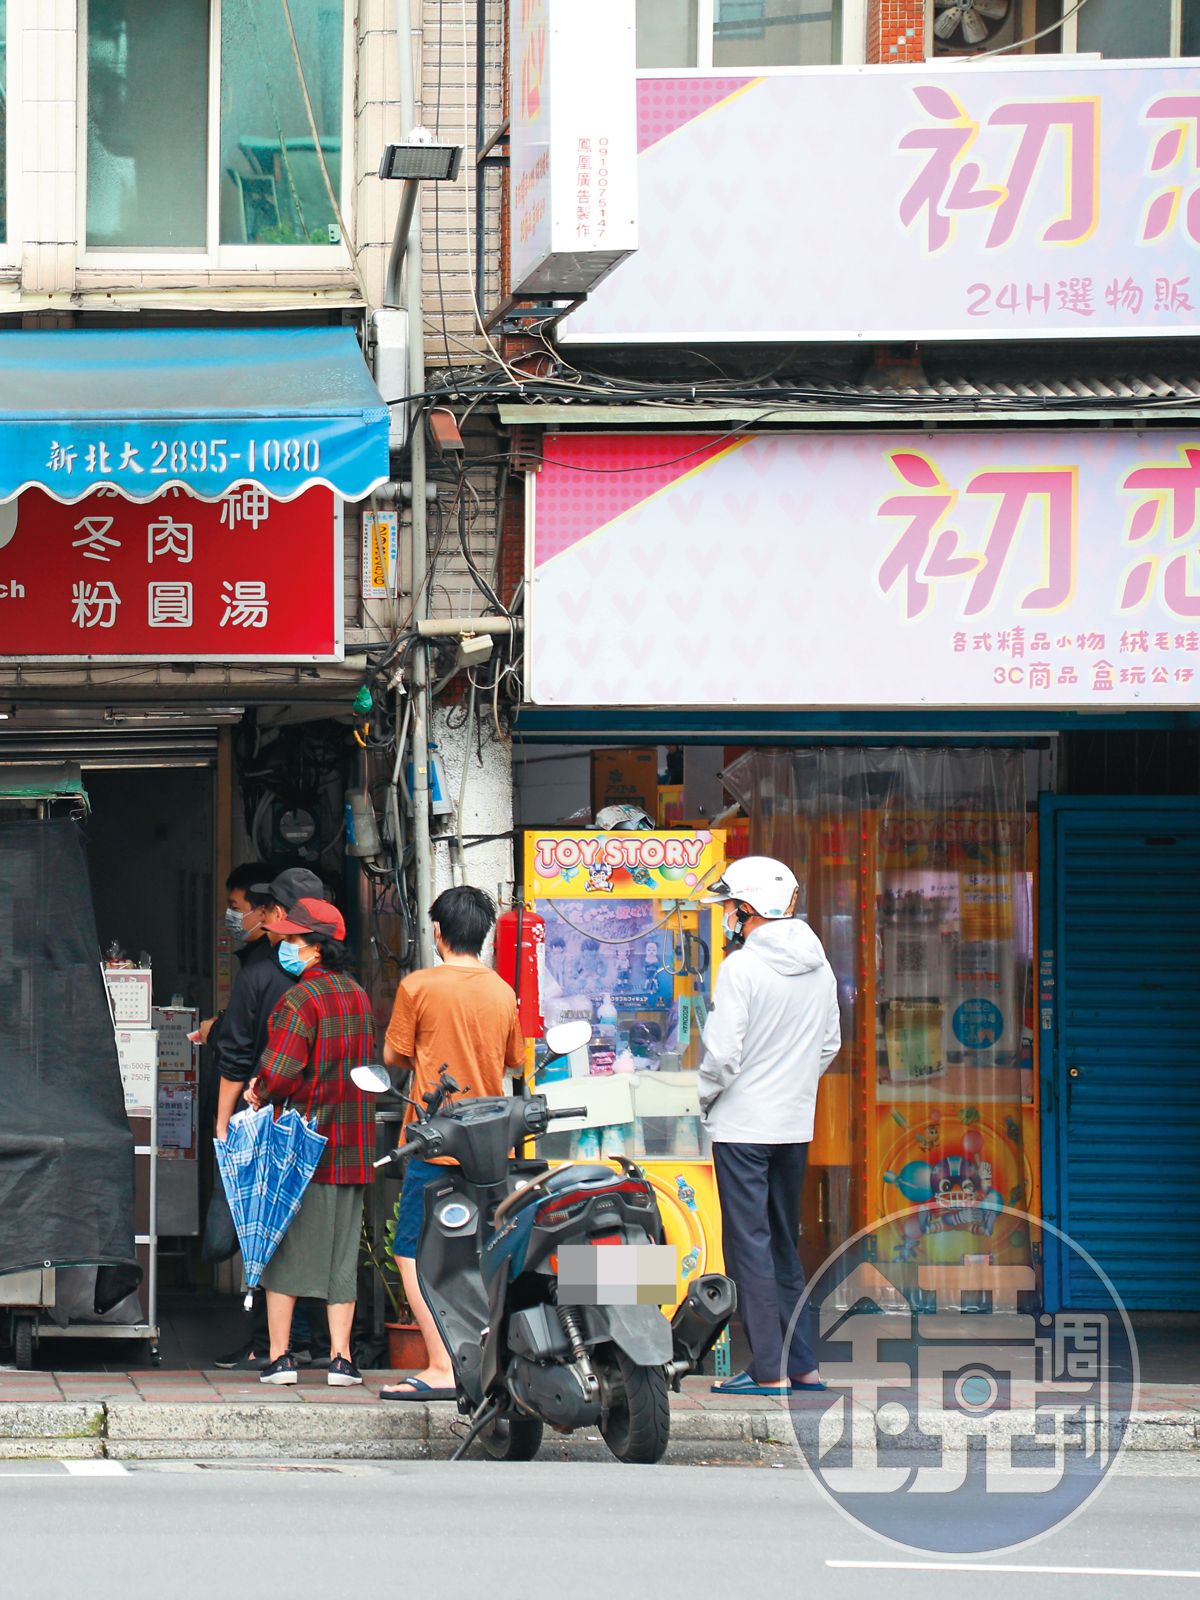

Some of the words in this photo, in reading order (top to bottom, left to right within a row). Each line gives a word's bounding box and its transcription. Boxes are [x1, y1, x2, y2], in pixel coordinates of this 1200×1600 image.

[577, 138, 592, 237] 鳳凰廣告製作
[953, 626, 1106, 658] 各式精品小物
[993, 662, 1078, 690] 3C商品
[1092, 659, 1194, 691] 盒玩公仔
[536, 838, 600, 868] TOY
[604, 838, 706, 868] STORY
